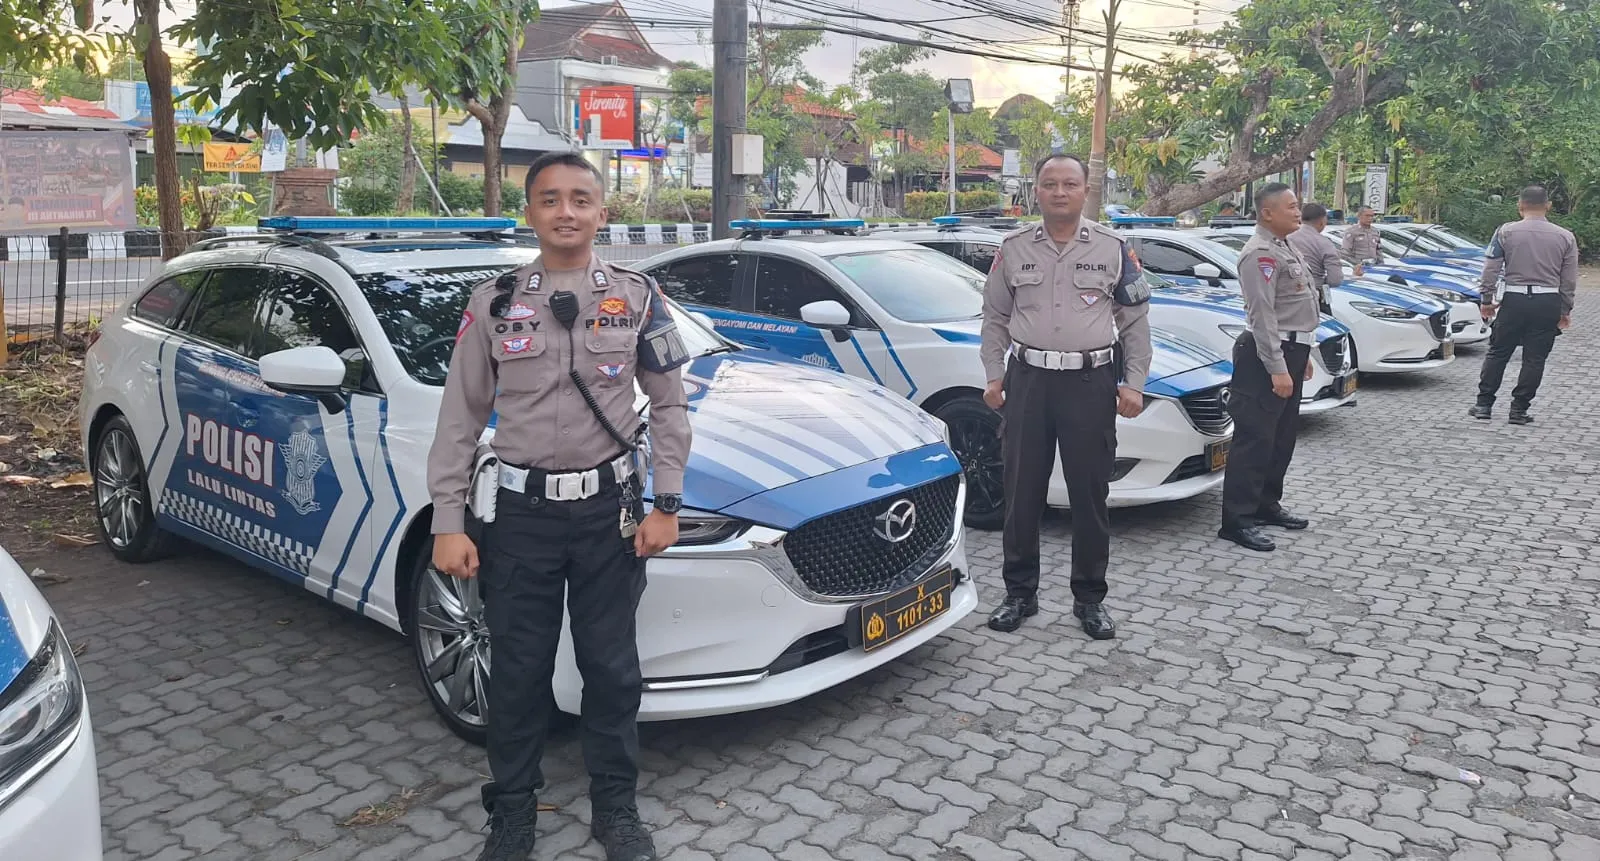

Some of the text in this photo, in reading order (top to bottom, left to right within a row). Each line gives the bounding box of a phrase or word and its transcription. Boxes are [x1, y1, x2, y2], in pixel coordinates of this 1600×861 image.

[585, 90, 627, 118] Serenity
[1075, 263, 1107, 272] POLRI
[585, 316, 633, 329] POLRI
[712, 318, 746, 329] ENGAYOMI
[747, 321, 763, 331] DAN
[186, 413, 275, 487] POLISI
[187, 468, 277, 518] LALU LINTAS
[917, 583, 925, 600] X
